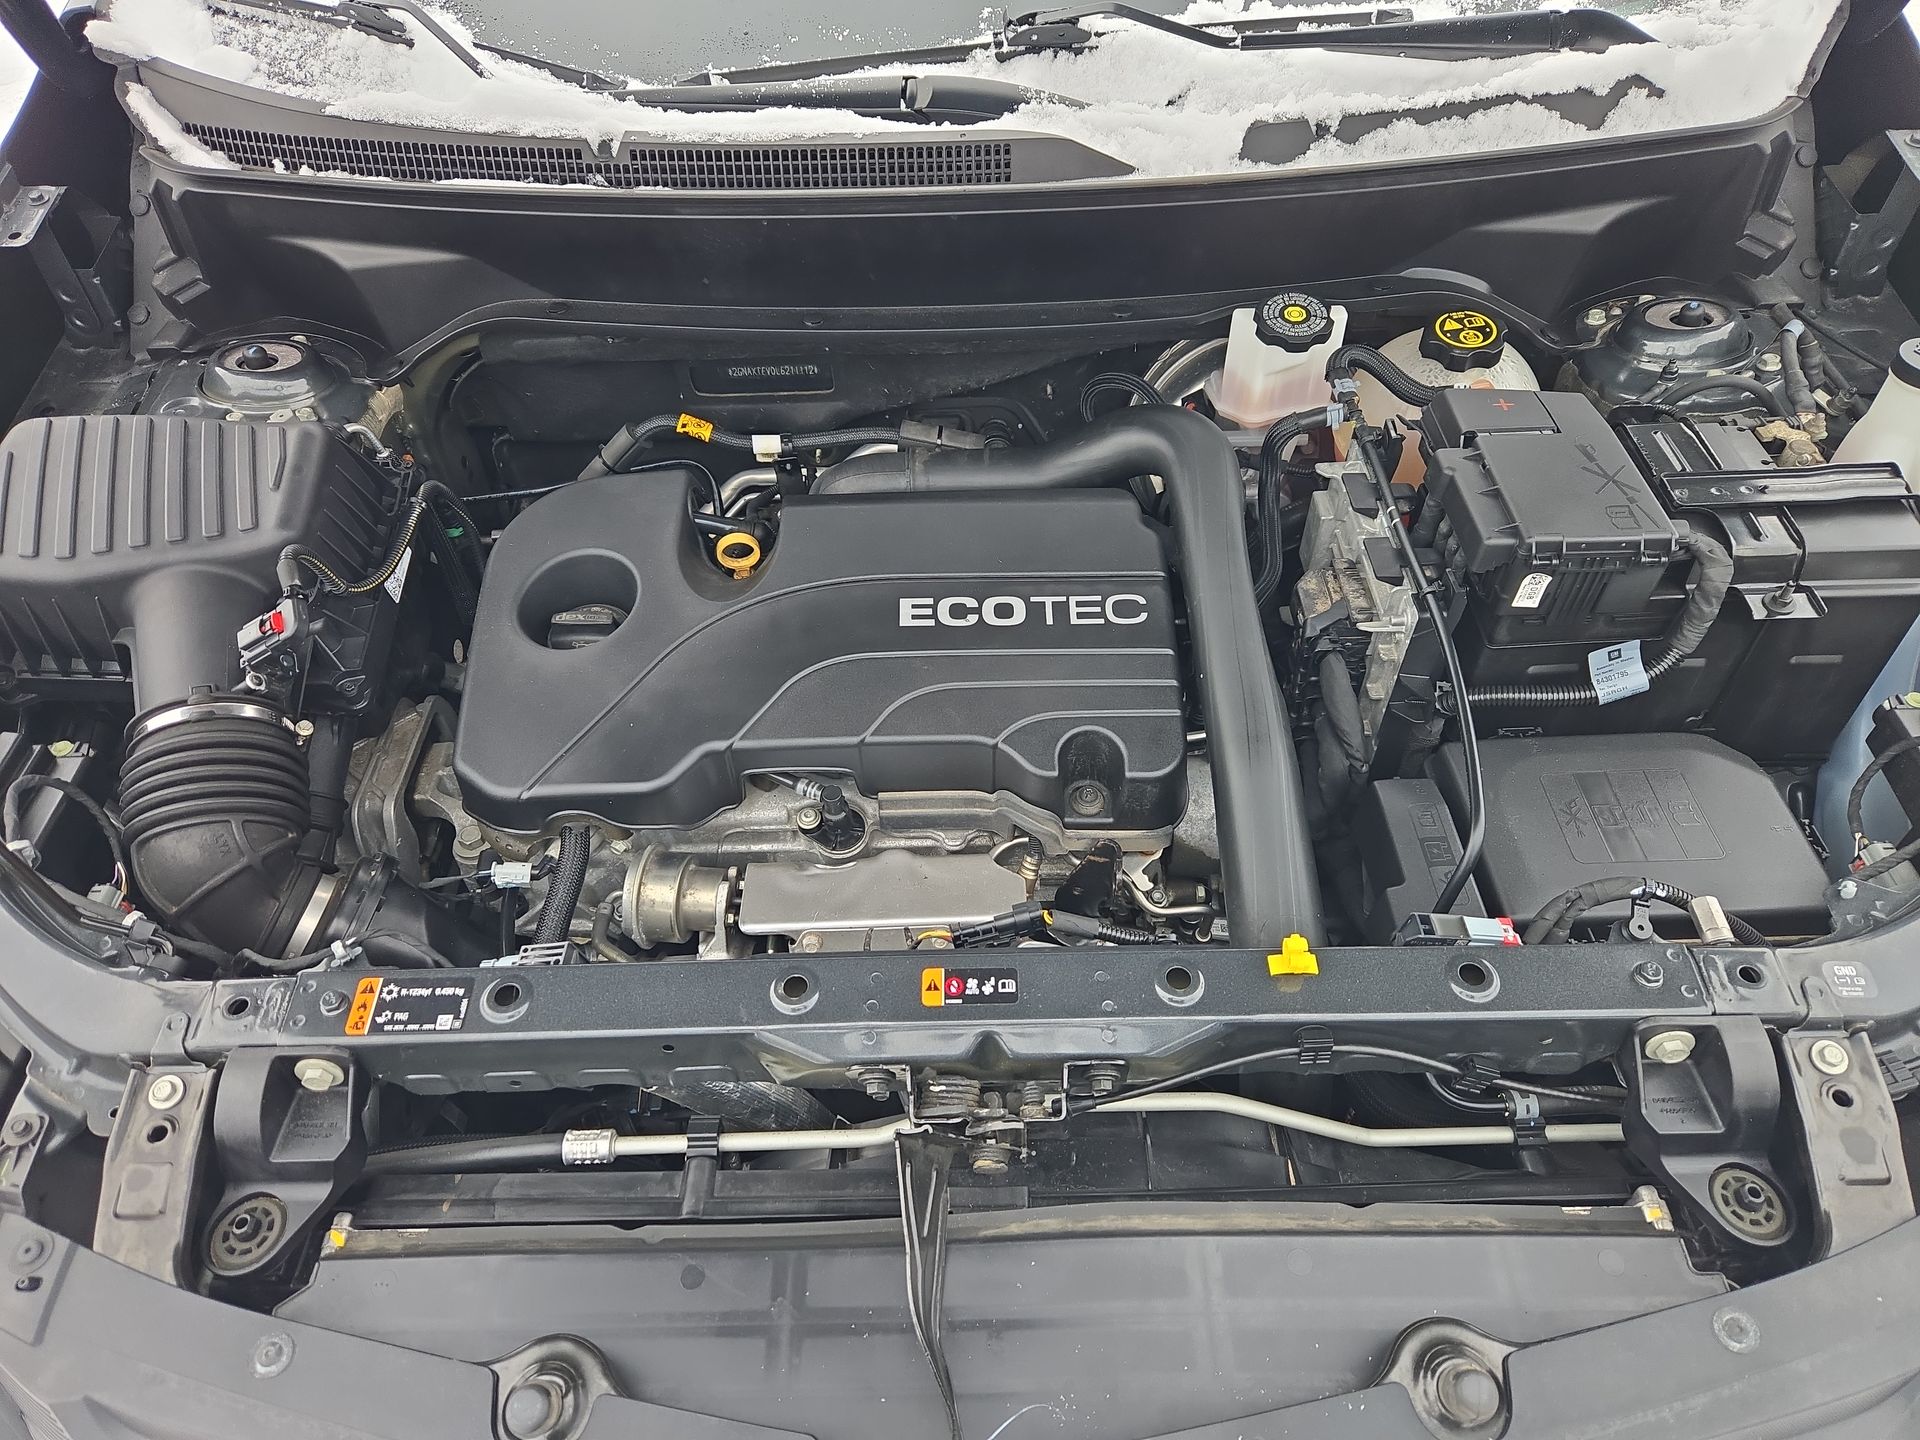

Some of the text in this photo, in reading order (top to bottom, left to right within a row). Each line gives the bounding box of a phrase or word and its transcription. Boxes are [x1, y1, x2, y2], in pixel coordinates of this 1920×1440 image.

[899, 594, 1148, 626] ECOTEC
[1596, 670, 1629, 685] 84301795
[1834, 966, 1856, 976] GND
[393, 1012, 409, 1021] PAG
